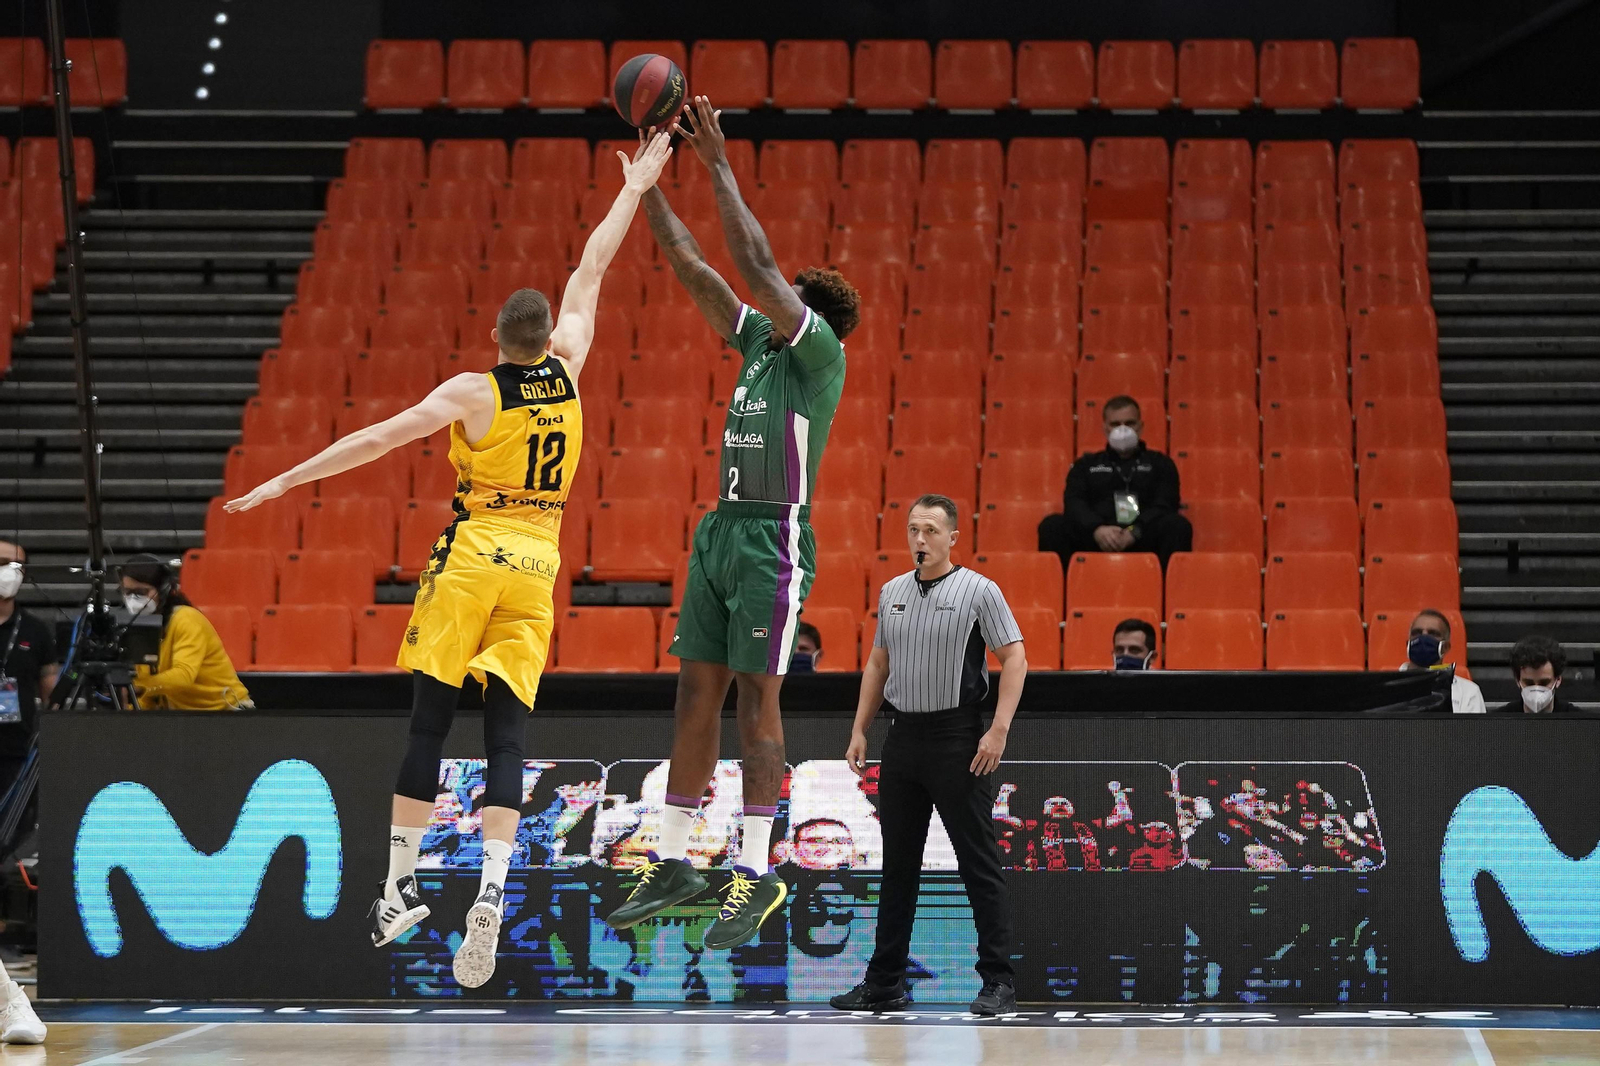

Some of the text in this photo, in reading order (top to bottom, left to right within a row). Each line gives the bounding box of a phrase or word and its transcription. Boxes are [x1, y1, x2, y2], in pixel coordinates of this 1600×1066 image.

[520, 377, 566, 400] GIELO
[524, 431, 567, 491] 12
[728, 466, 739, 500] 2
